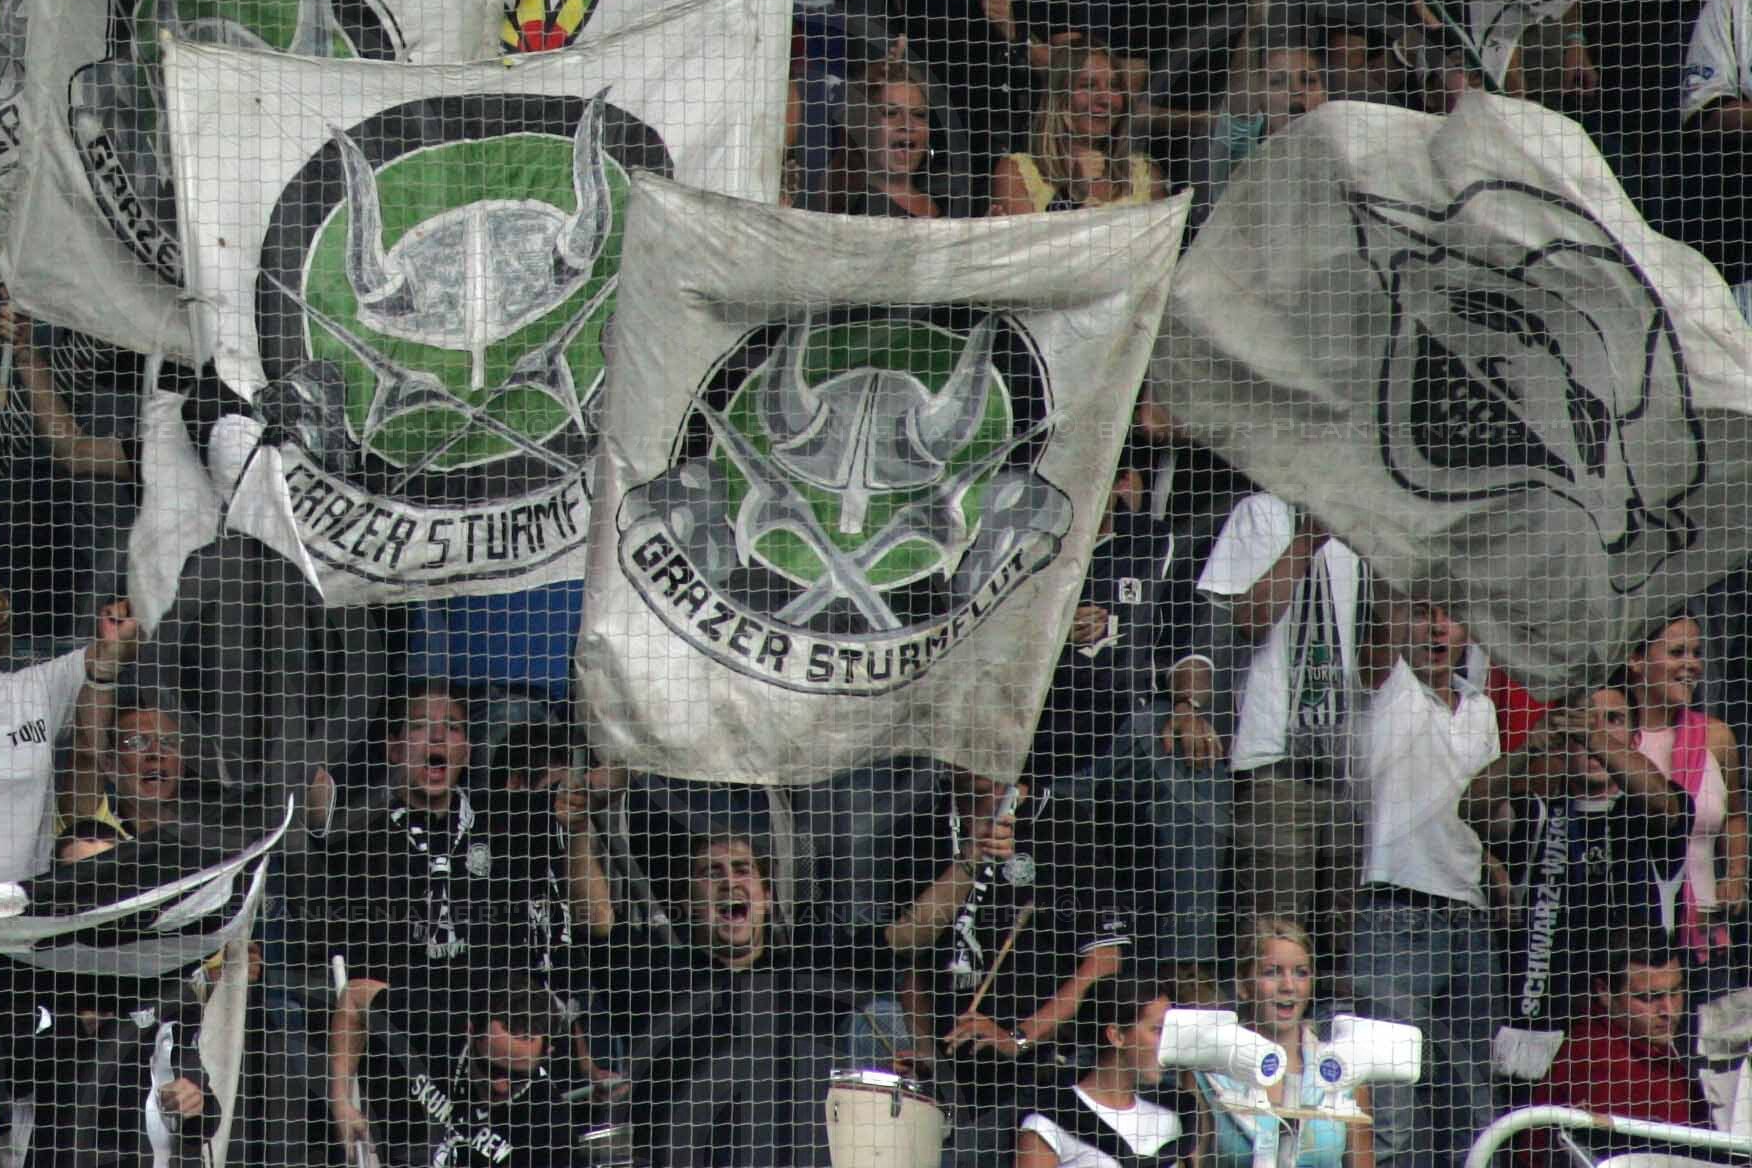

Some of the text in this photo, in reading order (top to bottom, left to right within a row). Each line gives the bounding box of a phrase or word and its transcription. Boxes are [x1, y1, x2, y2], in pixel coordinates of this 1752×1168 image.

[87, 134, 183, 279] GRAZE
[631, 532, 1028, 684] GRAZER STURMFLUT
[411, 1074, 514, 1164] SKUN REW
